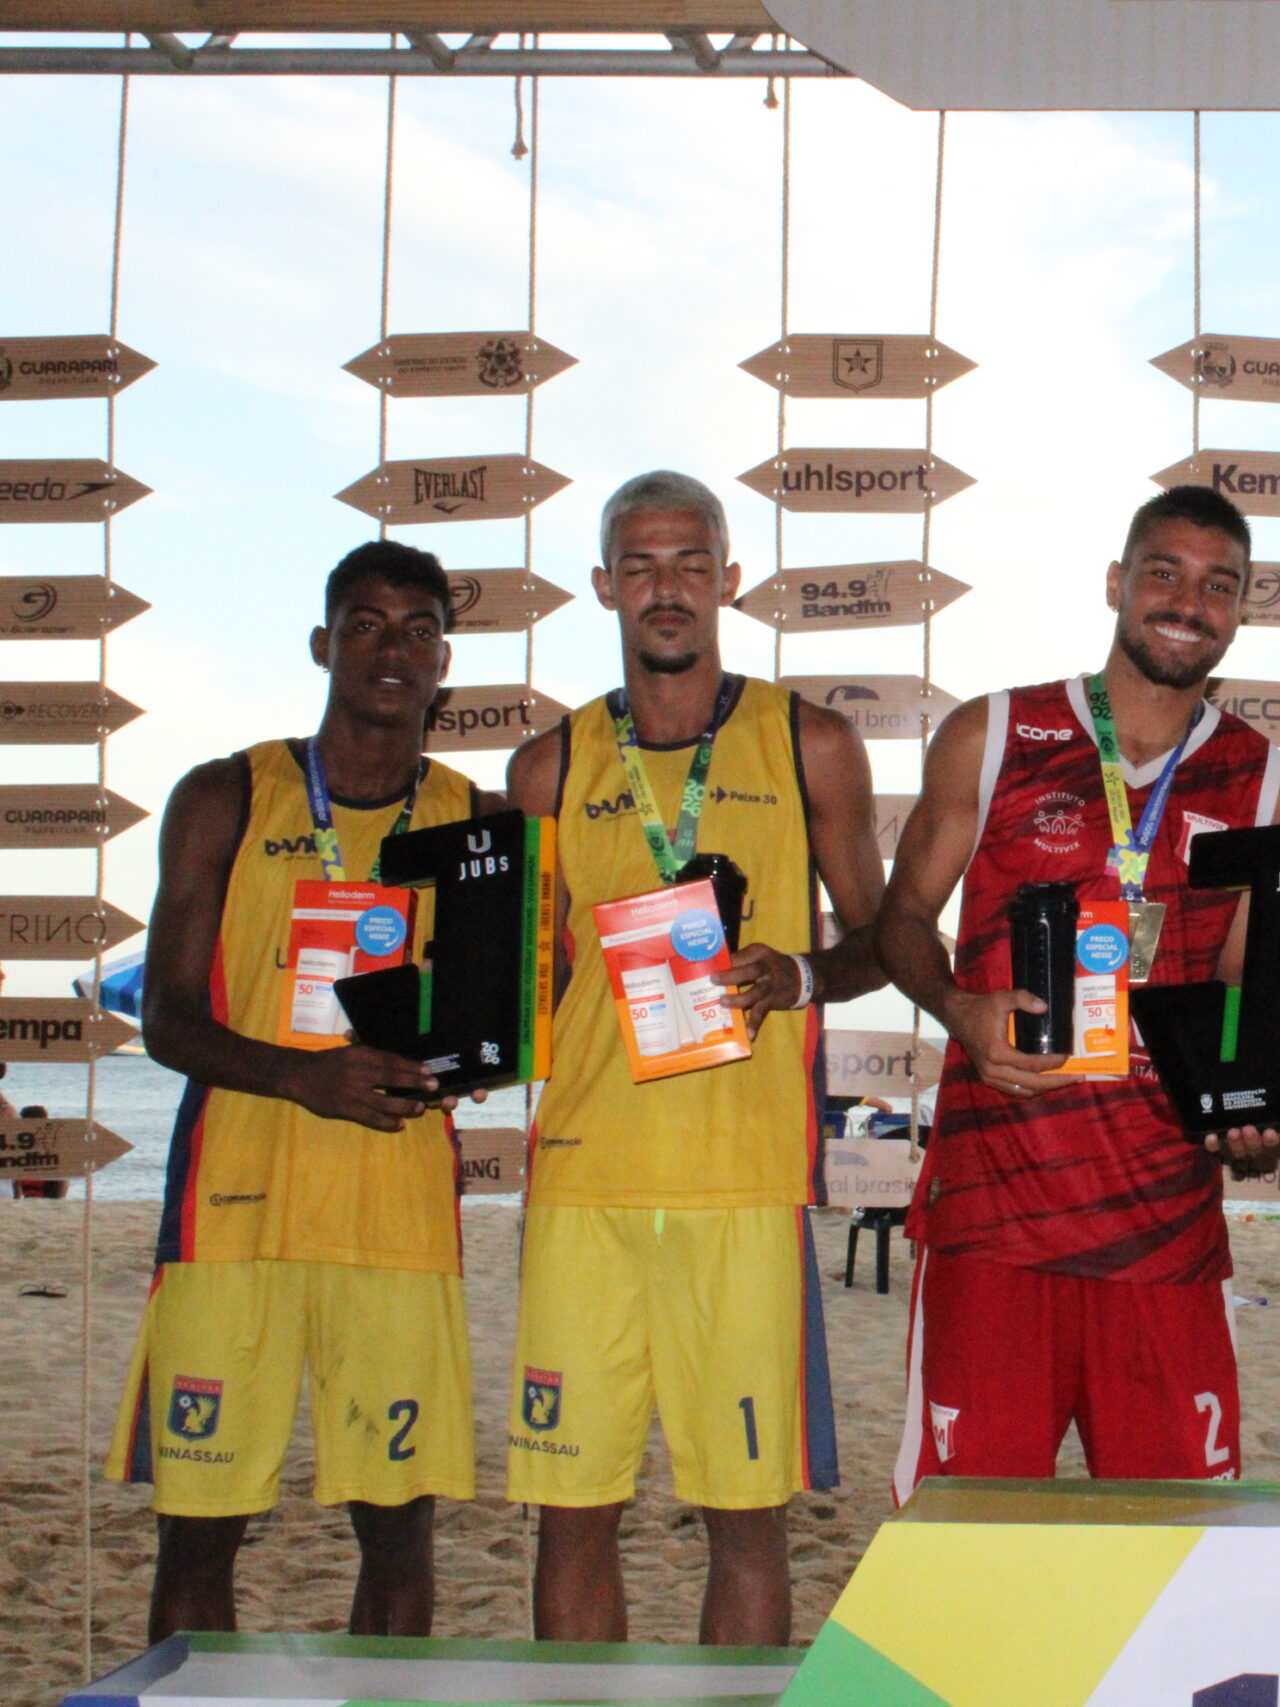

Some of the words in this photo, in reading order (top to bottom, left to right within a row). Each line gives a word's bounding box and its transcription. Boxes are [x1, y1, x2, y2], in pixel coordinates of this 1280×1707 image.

[19, 359, 117, 375] GUARAPARI
[413, 465, 487, 504] EVERLAST
[782, 464, 928, 497] uhlsport
[801, 579, 867, 601] 94.9
[432, 699, 530, 736] sport
[729, 791, 761, 803] Peixe
[763, 794, 777, 805] 30
[1034, 791, 1085, 807] INSTITUTO
[5, 809, 106, 825] GUARAPARI
[1185, 812, 1225, 831] MULTIVIX
[1033, 837, 1081, 854] MULTIVIX
[459, 856, 510, 881] JUBS
[328, 889, 375, 899] Helioderm
[680, 927, 714, 941] ESPECIAL
[1089, 935, 1115, 944] PREÇO
[1085, 943, 1119, 952] ESPECIAL
[1091, 951, 1113, 960] NESSE
[297, 983, 314, 995] 50
[631, 1006, 648, 1020] 50
[700, 1008, 717, 1022] 50
[1087, 1006, 1103, 1018] 50
[388, 1399, 419, 1461] 2
[738, 1396, 759, 1460] 1
[1194, 1391, 1230, 1467] 2
